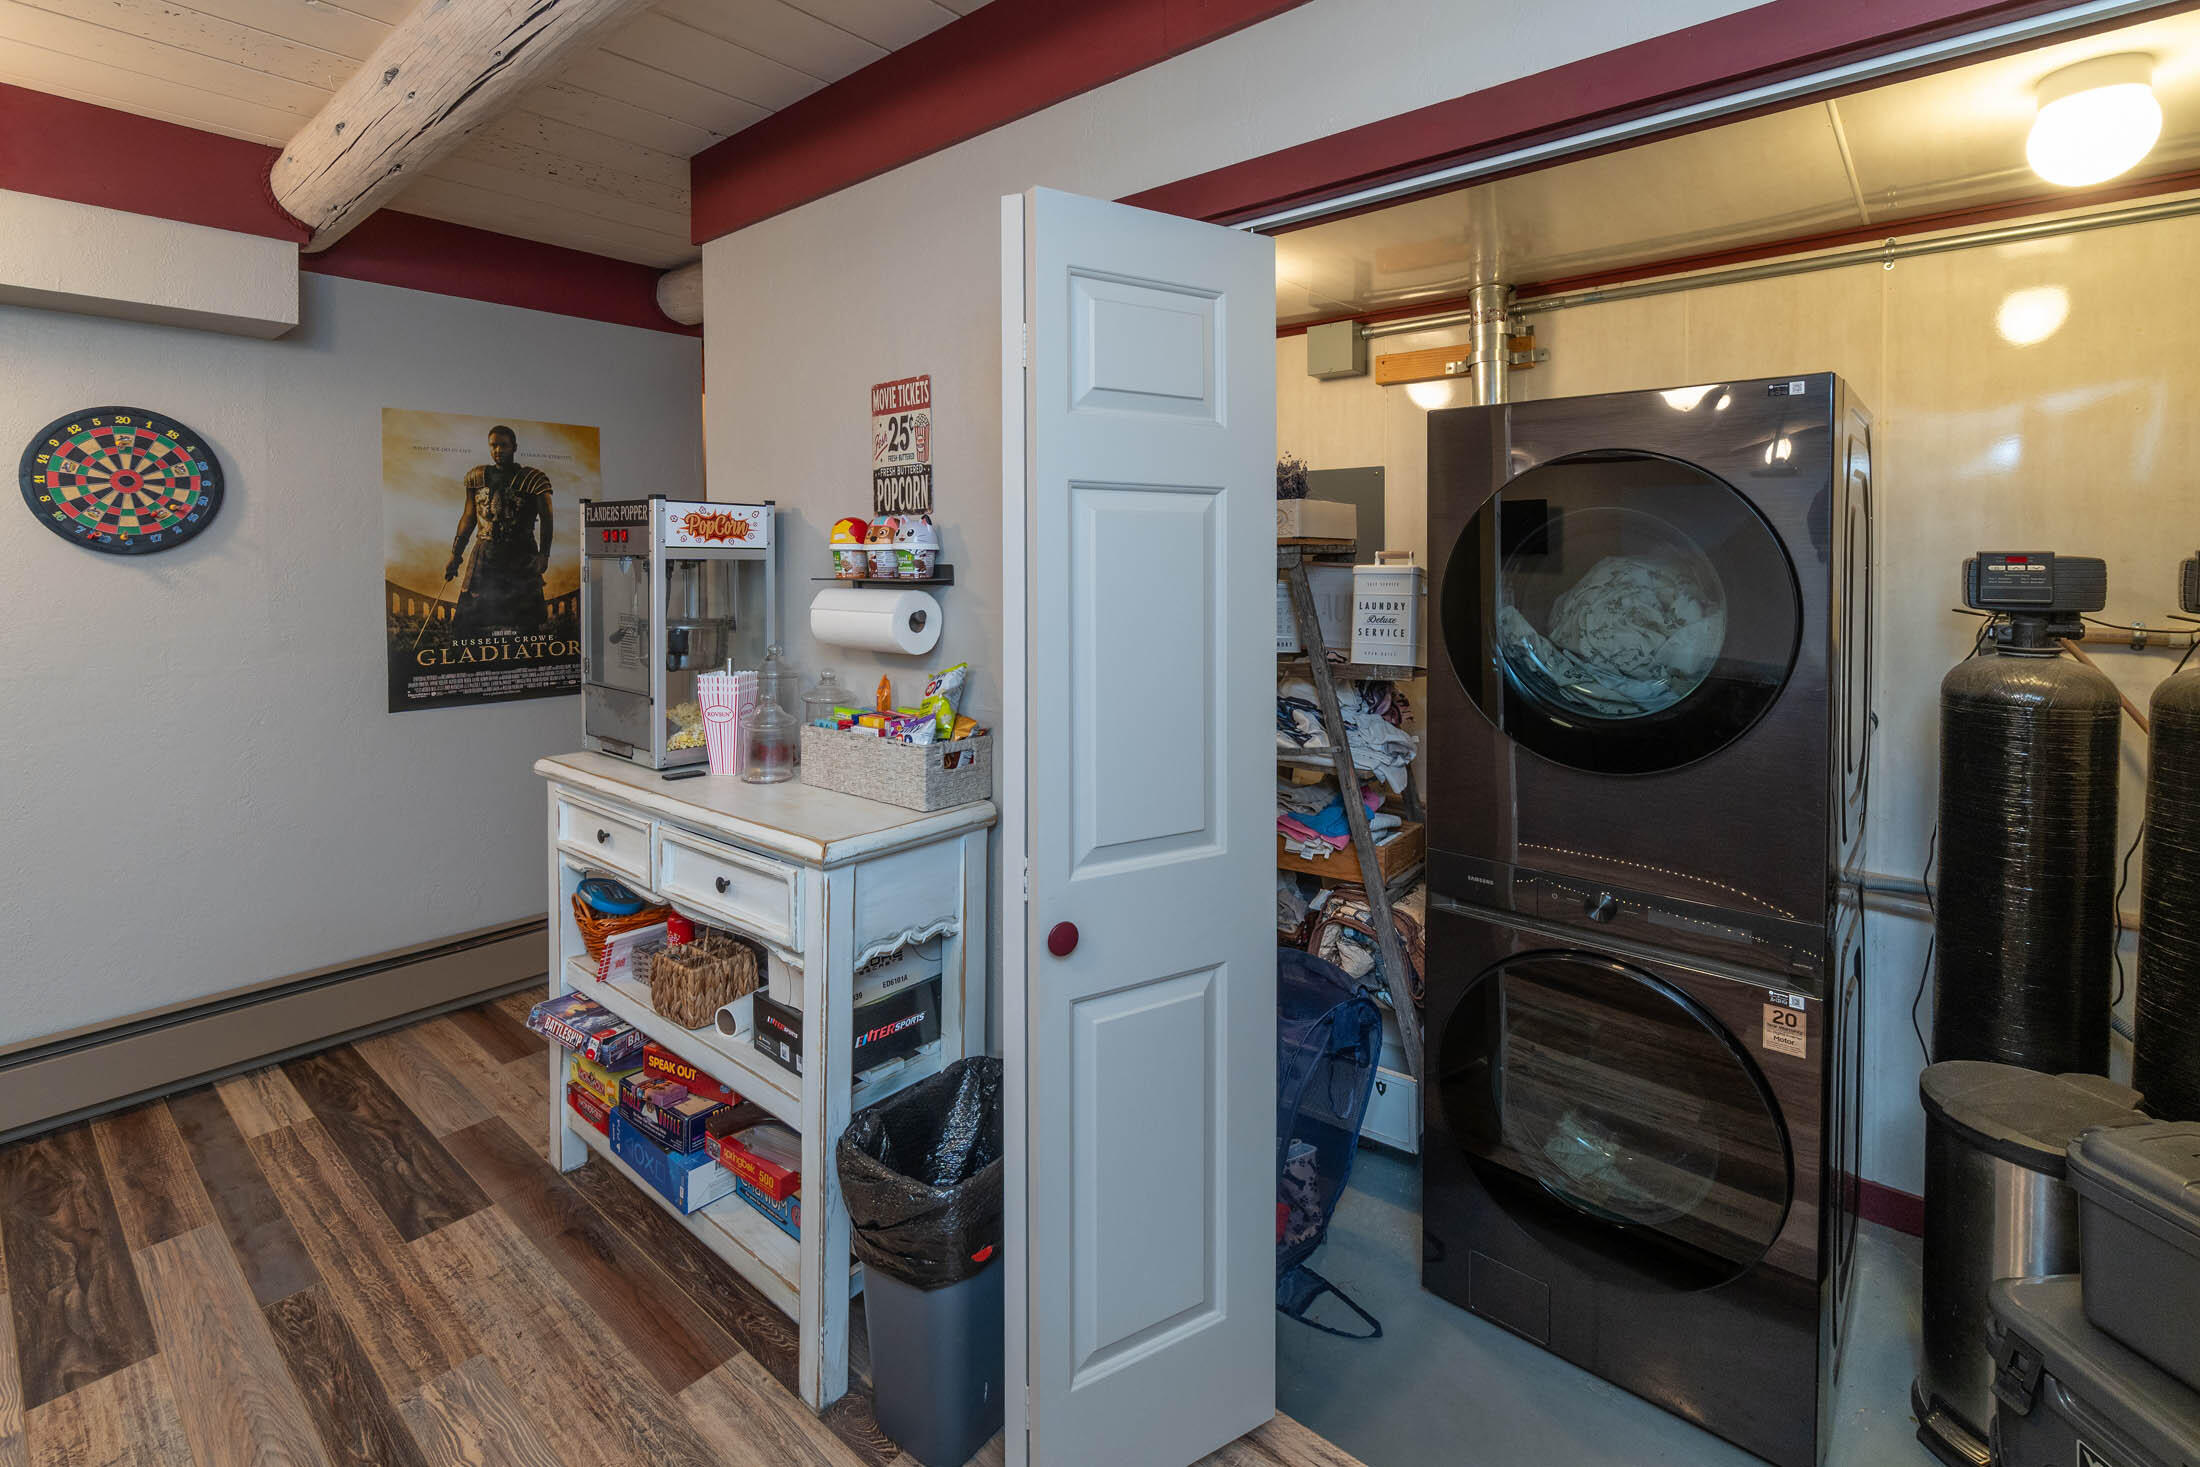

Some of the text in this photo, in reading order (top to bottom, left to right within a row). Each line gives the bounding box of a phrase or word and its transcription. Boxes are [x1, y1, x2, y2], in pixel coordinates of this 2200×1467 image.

[872, 380, 930, 411] MOVIE TICKETS
[92, 418, 101, 426] 5
[114, 416, 131, 425] 20
[146, 421, 153, 429] 1
[67, 424, 82, 435] 12
[166, 429, 180, 440] 18
[48, 439, 60, 447] 9
[37, 454, 50, 464] 14
[880, 464, 923, 477] FRESH BUTTERED
[33, 475, 46, 483] 11
[877, 474, 929, 512] POPCORN
[586, 504, 648, 521] FLANDERS POPPER
[684, 513, 750, 540] PopCorn
[1359, 601, 1406, 611] LAUNDRY
[1367, 614, 1397, 624] Deluxe
[1358, 628, 1405, 638] SERVICE
[453, 637, 508, 647] RUSSELL
[514, 634, 555, 643] CROWE
[416, 640, 581, 667] GLADIATOR
[1772, 1009, 1797, 1028] 20
[544, 1016, 584, 1048] BATTLESHIP
[1773, 1035, 1795, 1046] Motor
[648, 1055, 697, 1081] SPEAK OUT
[759, 1168, 775, 1189] 500
